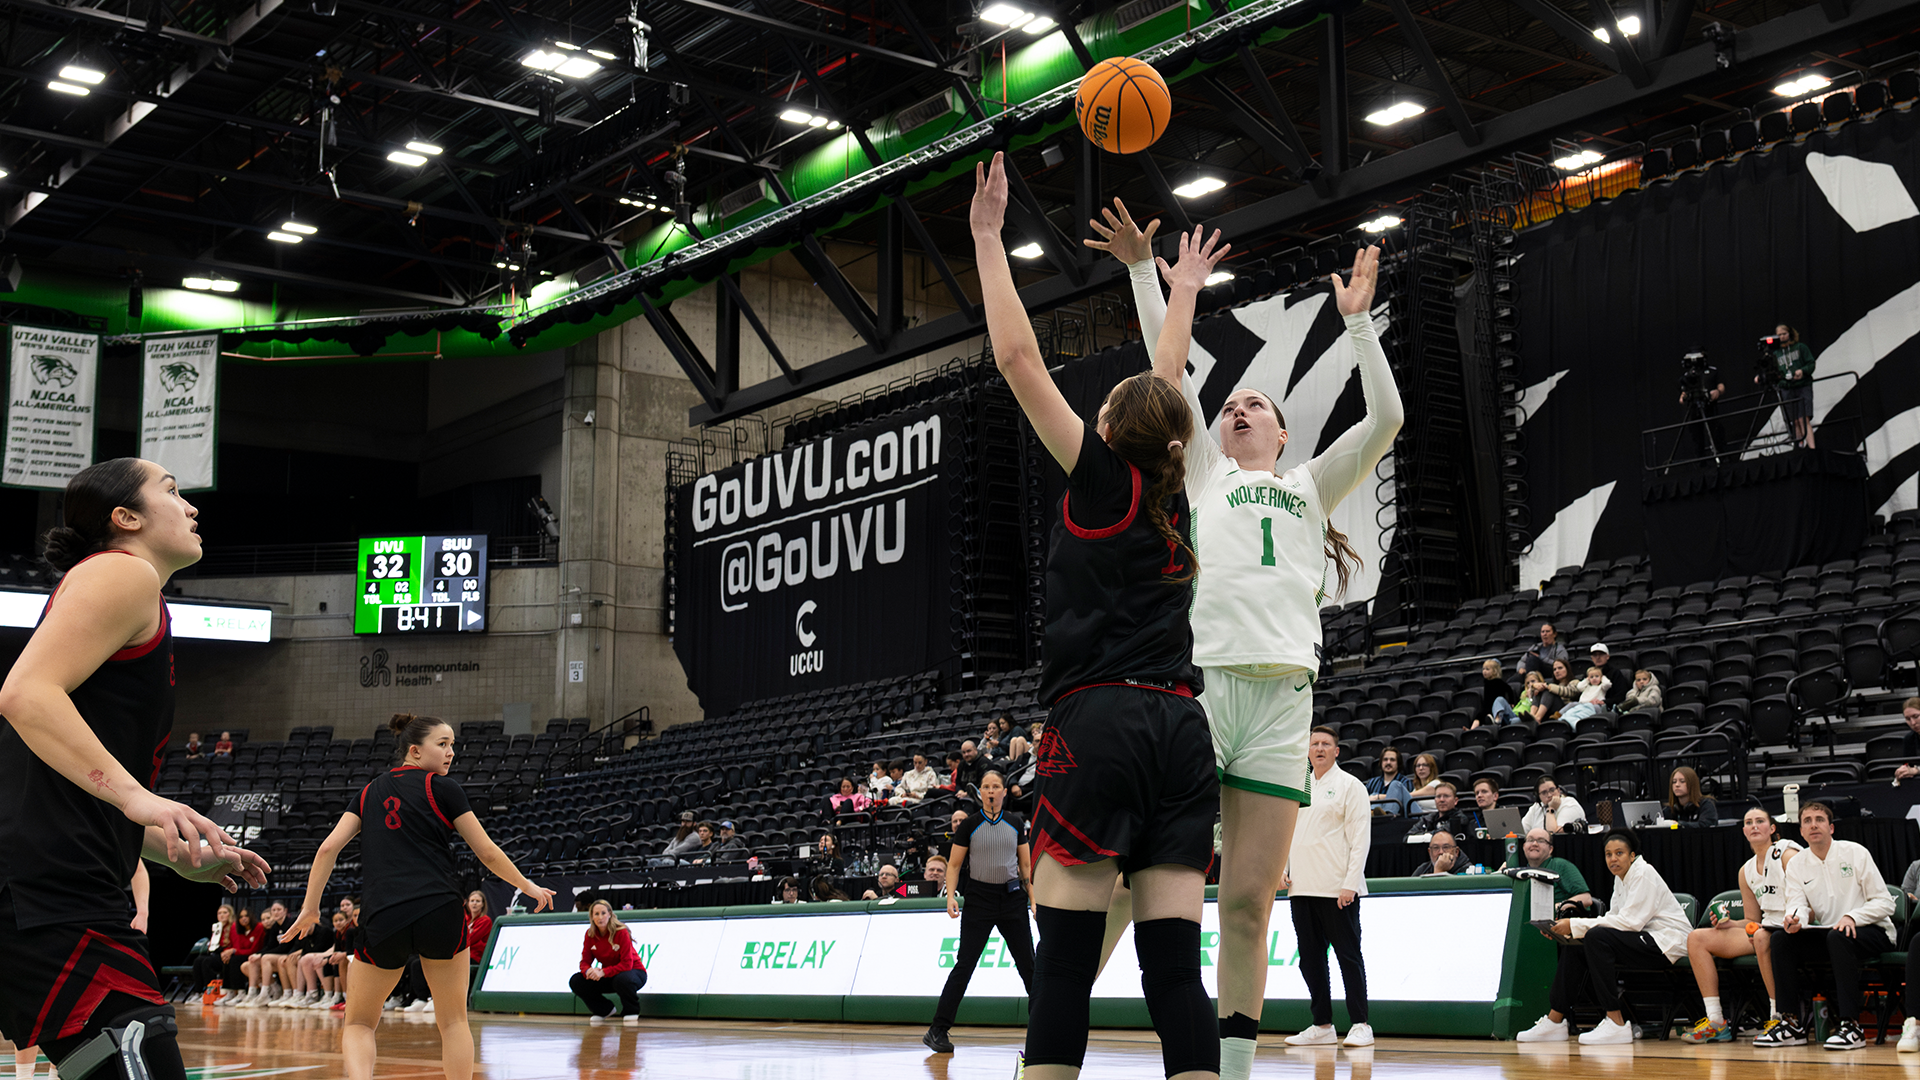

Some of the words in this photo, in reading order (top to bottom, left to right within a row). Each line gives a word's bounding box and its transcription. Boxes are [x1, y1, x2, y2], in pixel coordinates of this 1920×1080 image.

[14, 331, 48, 342] UTAH
[52, 335, 96, 348] VALLEY
[147, 343, 175, 353] UTAH
[177, 339, 215, 350] VALLEY
[20, 342, 43, 350] MEN'S
[45, 344, 91, 355] BASKETBALL
[172, 349, 211, 358] BASKETBALL
[30, 389, 76, 404] NJCAA
[163, 396, 194, 408] NCAA
[12, 400, 92, 414] ALL-AMERICANS
[145, 405, 211, 418] ALL-AMERICANS
[692, 414, 941, 532] GoUVU.com
[1226, 485, 1307, 518] WOLVERINES
[373, 540, 404, 554] UVU
[441, 538, 472, 551] SUU
[1261, 517, 1276, 567] 1
[721, 498, 906, 612] @GoUVU
[372, 554, 404, 579] 32
[440, 552, 472, 576] 30
[368, 583, 377, 594] 4
[395, 581, 409, 592] 02
[436, 580, 445, 591] 4
[463, 579, 477, 590] 00
[393, 593, 412, 604] FLS
[462, 591, 480, 602] FLS
[216, 617, 267, 630] RELAY
[397, 606, 442, 631] 8:41
[396, 660, 480, 674] Intermountain
[570, 662, 583, 670] SEC
[790, 650, 823, 676] UCCU
[396, 675, 432, 687] Health
[573, 671, 580, 681] 3
[214, 793, 280, 806] STUDENT
[383, 796, 402, 830] 8
[756, 940, 837, 969] RELAY
